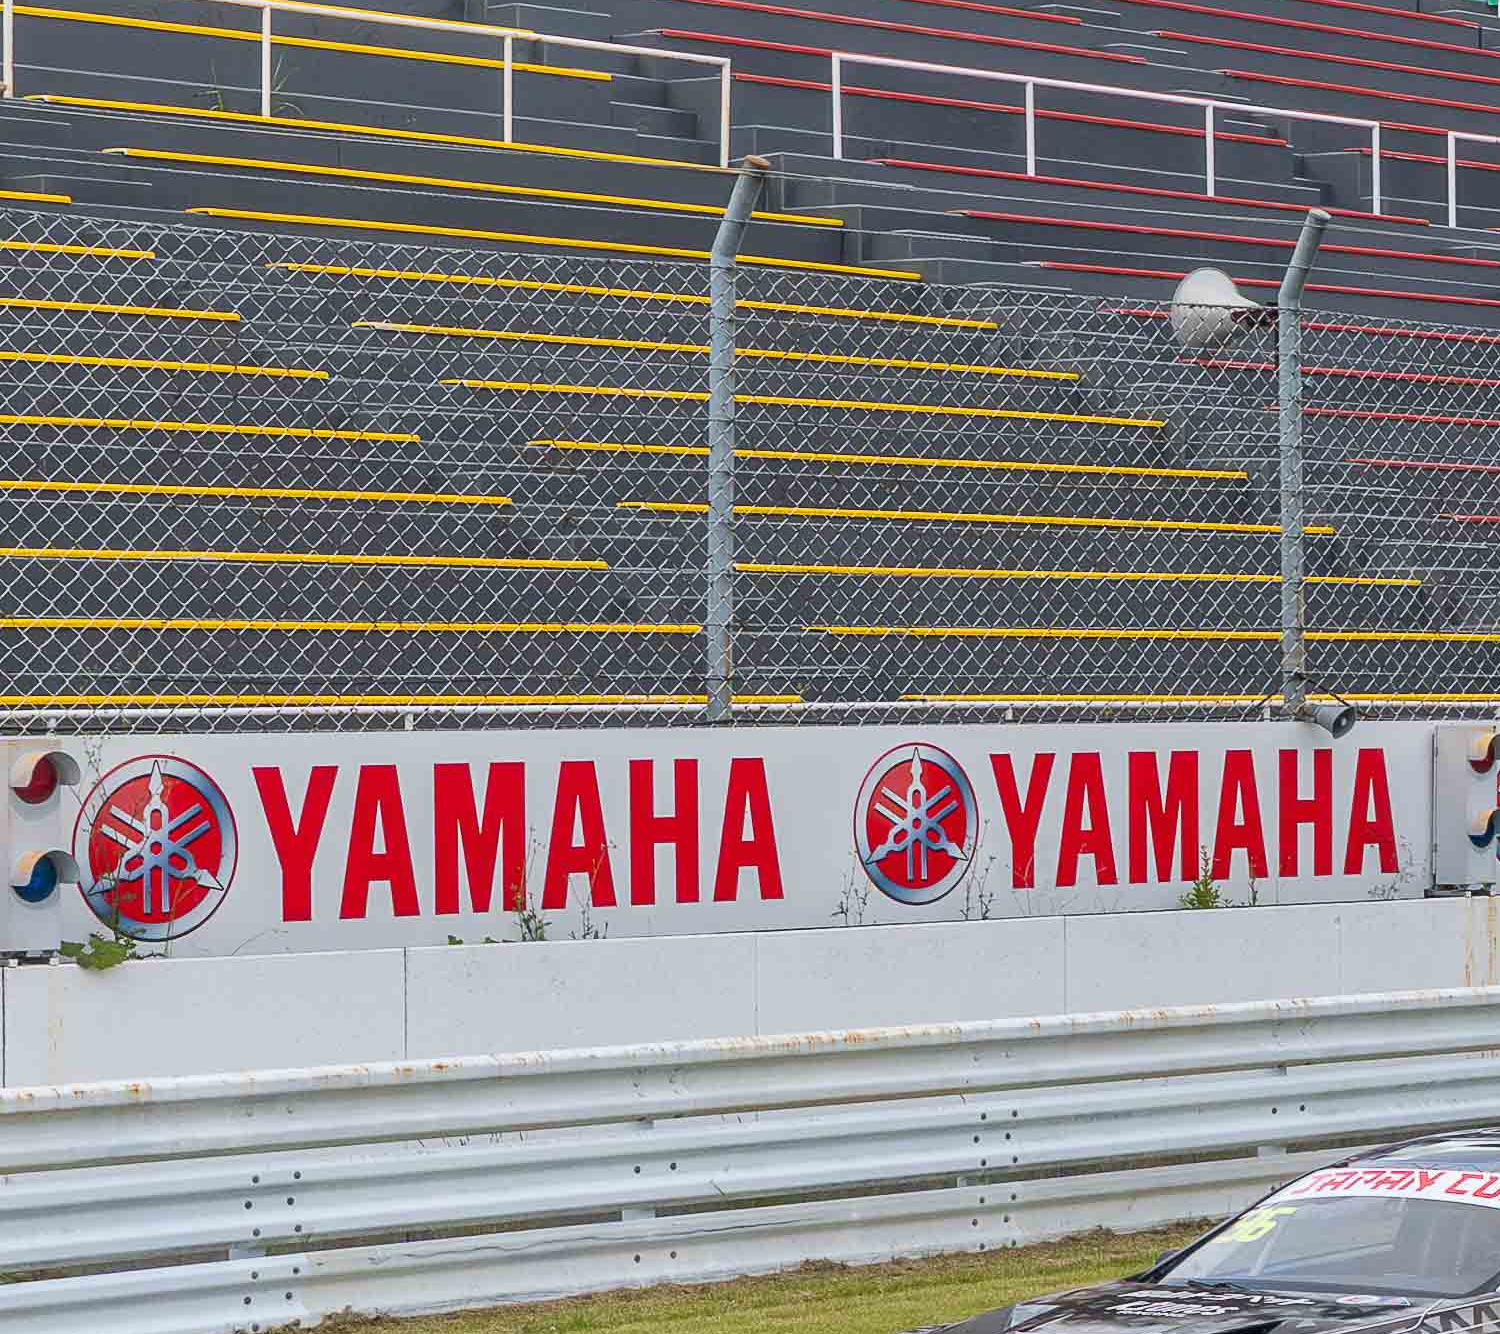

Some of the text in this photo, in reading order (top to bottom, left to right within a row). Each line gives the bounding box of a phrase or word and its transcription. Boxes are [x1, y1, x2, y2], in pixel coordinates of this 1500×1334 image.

[253, 756, 785, 924] YAMAHA
[990, 747, 1400, 889] YAMAHA
[1290, 1169, 1443, 1197] JAPAN
